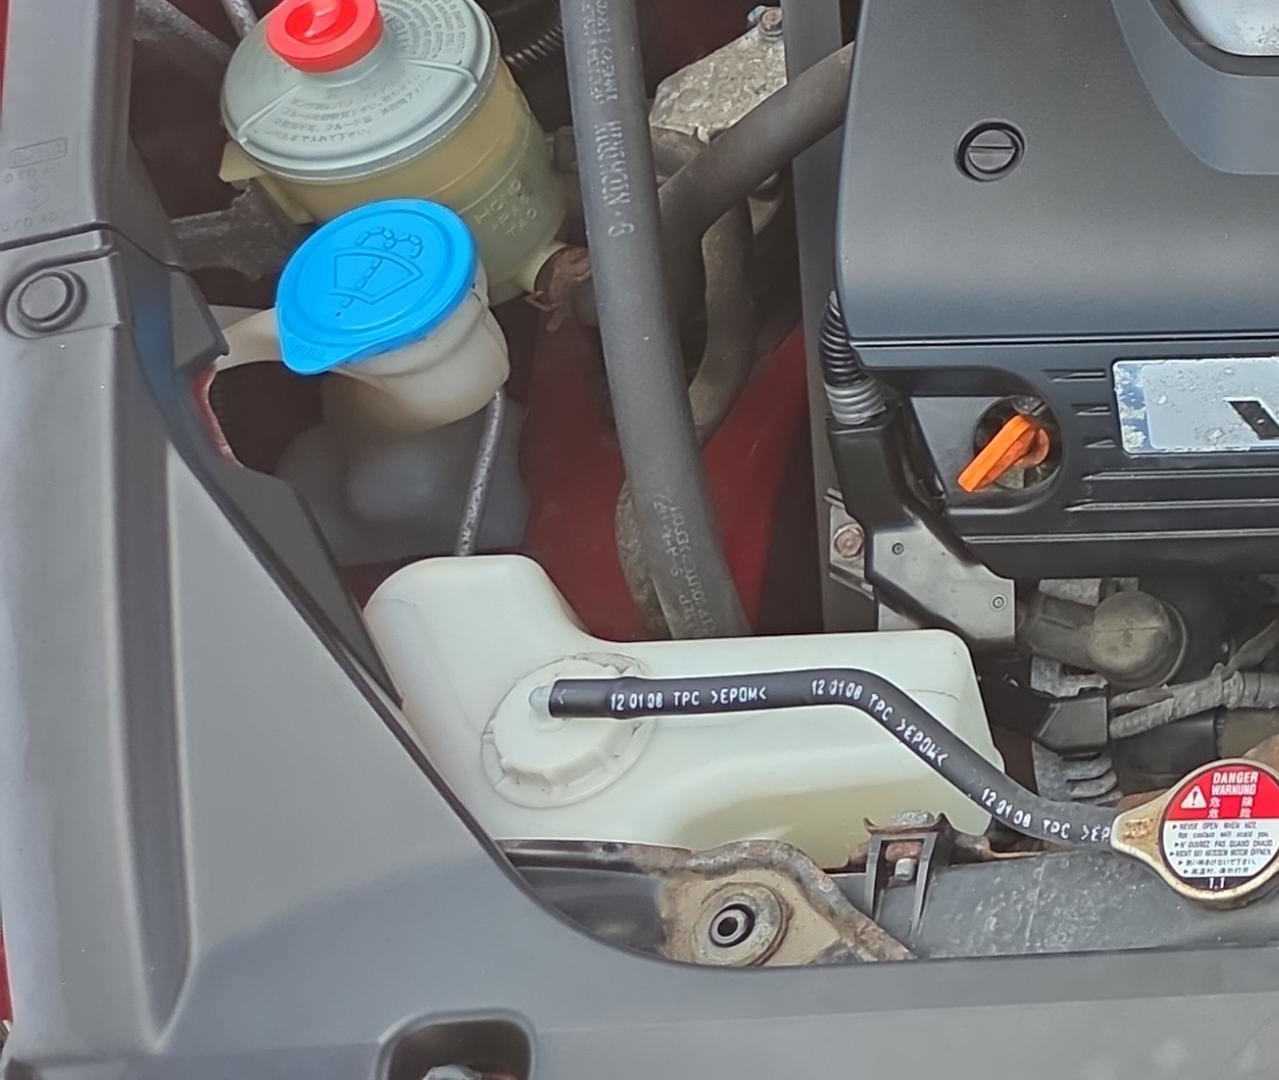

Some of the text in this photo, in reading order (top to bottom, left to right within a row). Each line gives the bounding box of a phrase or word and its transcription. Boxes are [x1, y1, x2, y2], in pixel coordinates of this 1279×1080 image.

[611, 693, 625, 711] 12
[628, 692, 643, 710] 01
[673, 690, 700, 707] TPC
[811, 679, 825, 696] 12
[828, 679, 844, 697] 01
[868, 693, 894, 721] TPC
[1213, 771, 1259, 784] DANGER
[1211, 783, 1257, 796] WARNUNG
[981, 788, 997, 807] 12
[995, 799, 1013, 818] 01
[1043, 819, 1071, 839] TPC
[1210, 877, 1225, 889] 1.1
